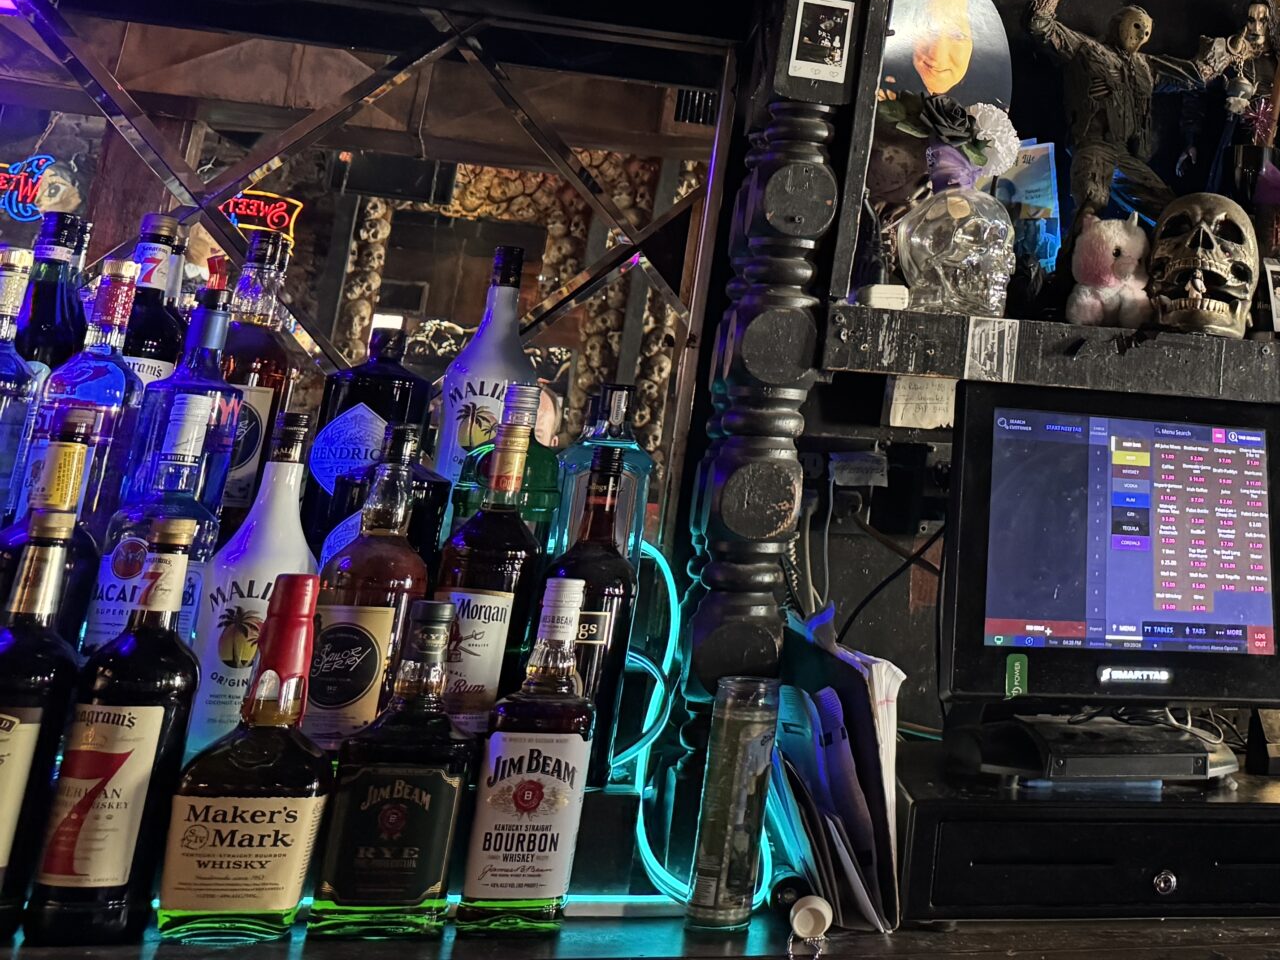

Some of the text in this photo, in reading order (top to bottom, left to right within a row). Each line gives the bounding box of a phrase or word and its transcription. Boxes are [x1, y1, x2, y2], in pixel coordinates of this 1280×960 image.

[1162, 428, 1191, 437] Menu Search
[312, 445, 382, 461] HENDRIC
[457, 599, 508, 624] Morgan
[1154, 626, 1174, 634] TABLES
[1226, 628, 1243, 636] MORE
[77, 707, 137, 728] agram's
[485, 748, 577, 789] JIM BEAM
[362, 779, 431, 811] JIM BEAM
[183, 805, 298, 825] Maker's
[494, 823, 552, 833] KENTUCKY STRAIGHT
[208, 829, 291, 849] Mark
[482, 832, 559, 852] BOURBON
[357, 847, 420, 861] RYE
[502, 853, 535, 863] WHISKEY
[196, 859, 271, 870] WHISKY
